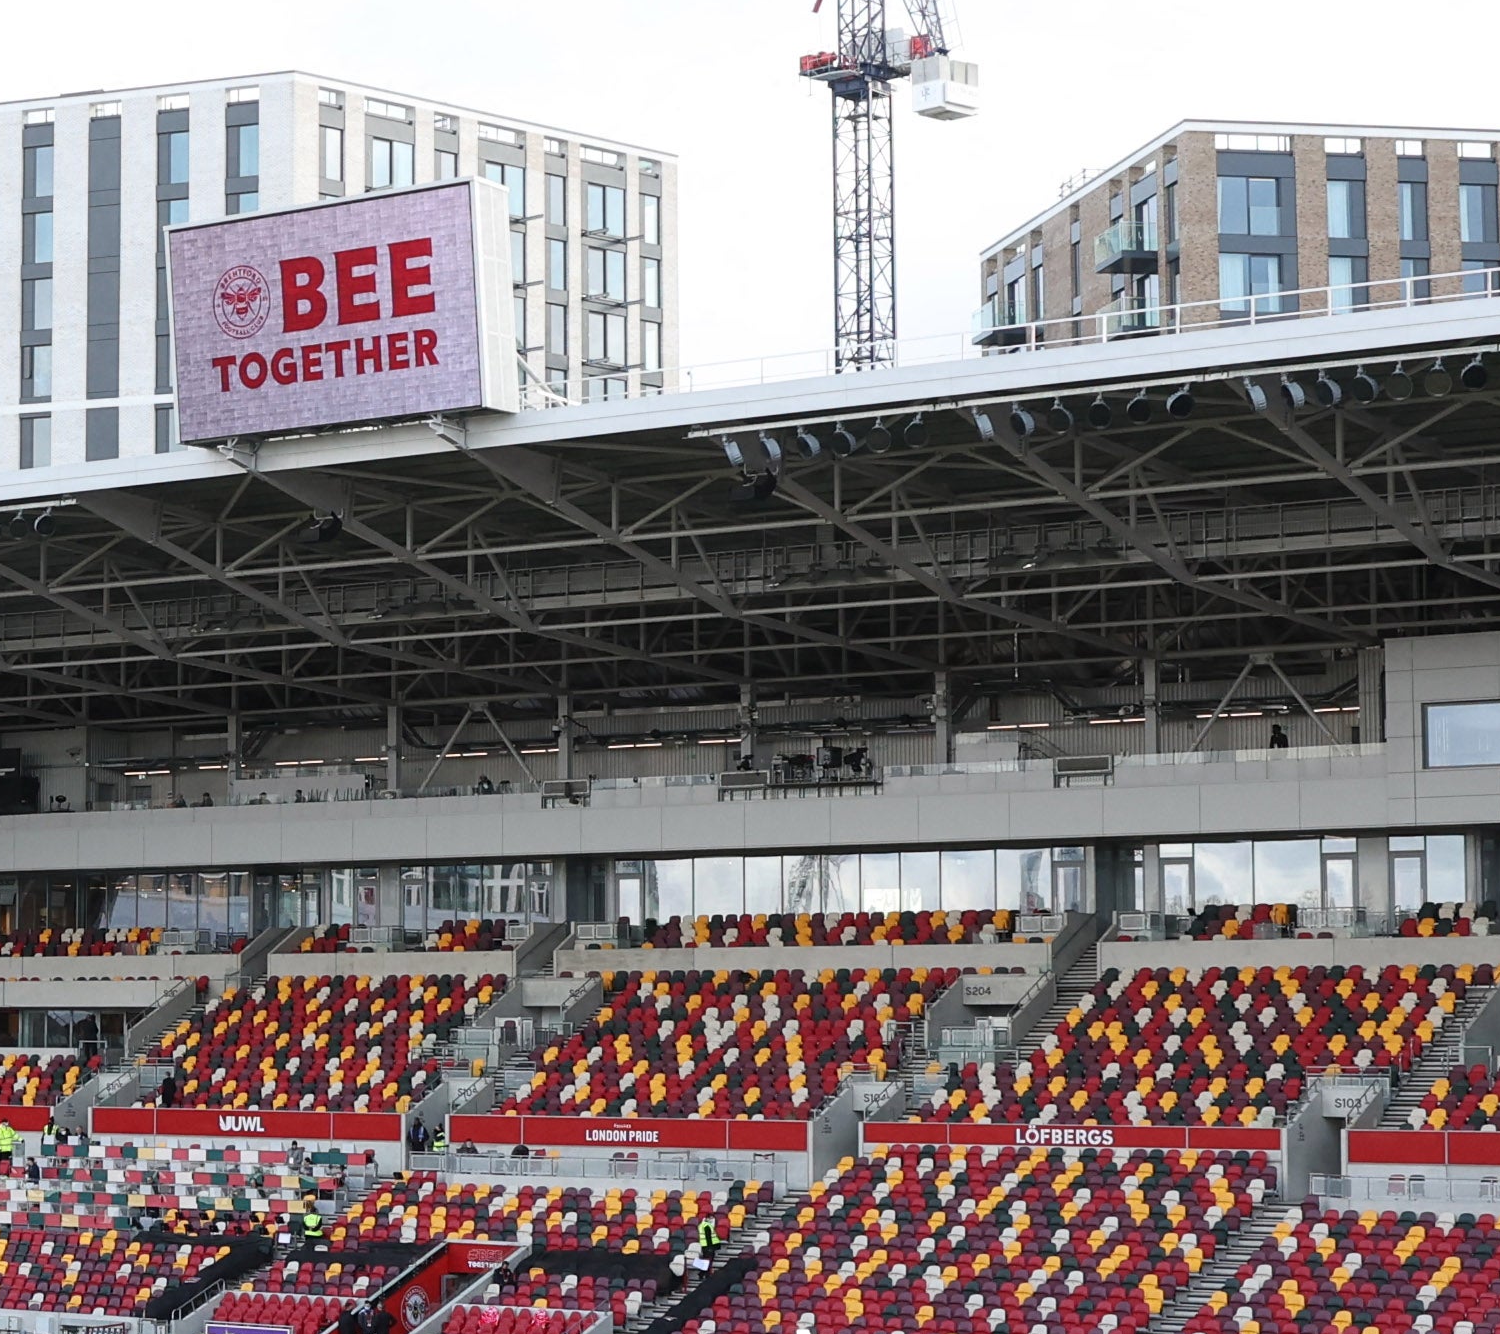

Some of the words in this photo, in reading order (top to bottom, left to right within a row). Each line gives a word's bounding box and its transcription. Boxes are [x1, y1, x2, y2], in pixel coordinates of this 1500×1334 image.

[220, 267, 262, 290] BRENTFORD
[279, 237, 436, 334] BEE
[211, 329, 440, 393] TOGETHER
[965, 986, 992, 996] S204
[585, 1129, 627, 1142] LONDON
[628, 1130, 659, 1143] PRIDE
[1015, 1125, 1114, 1146] LÖFBERGS
